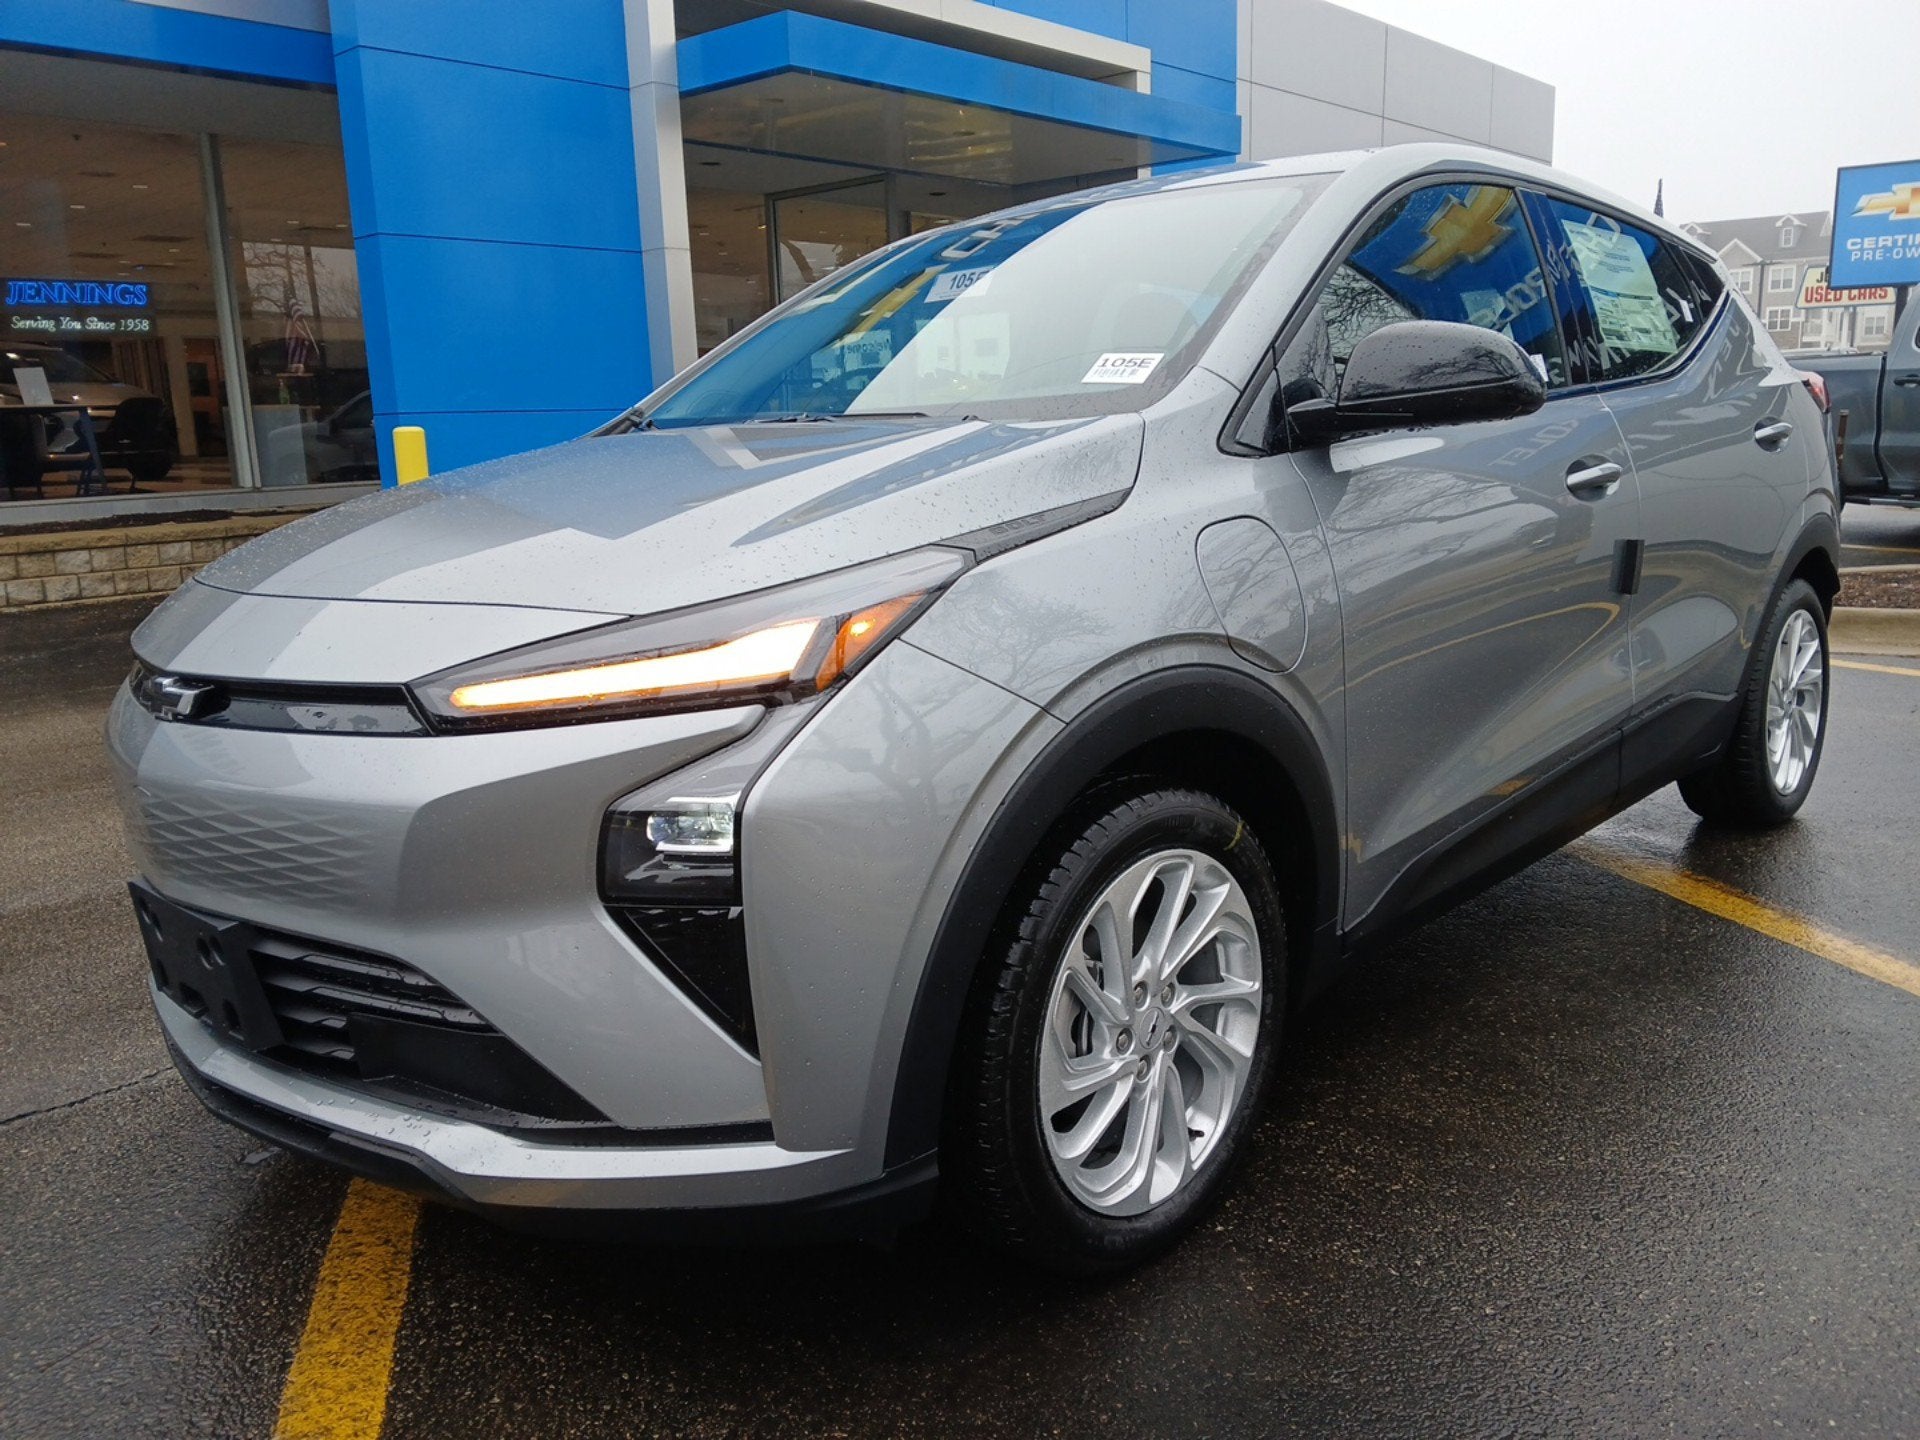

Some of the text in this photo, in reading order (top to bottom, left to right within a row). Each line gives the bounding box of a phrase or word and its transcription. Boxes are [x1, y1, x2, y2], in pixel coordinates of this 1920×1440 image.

[5, 281, 148, 305] JENNINGS
[1804, 286, 1888, 304] USED CARS
[11, 315, 150, 332] Serving You Since 1958
[1098, 358, 1154, 368] 105E
